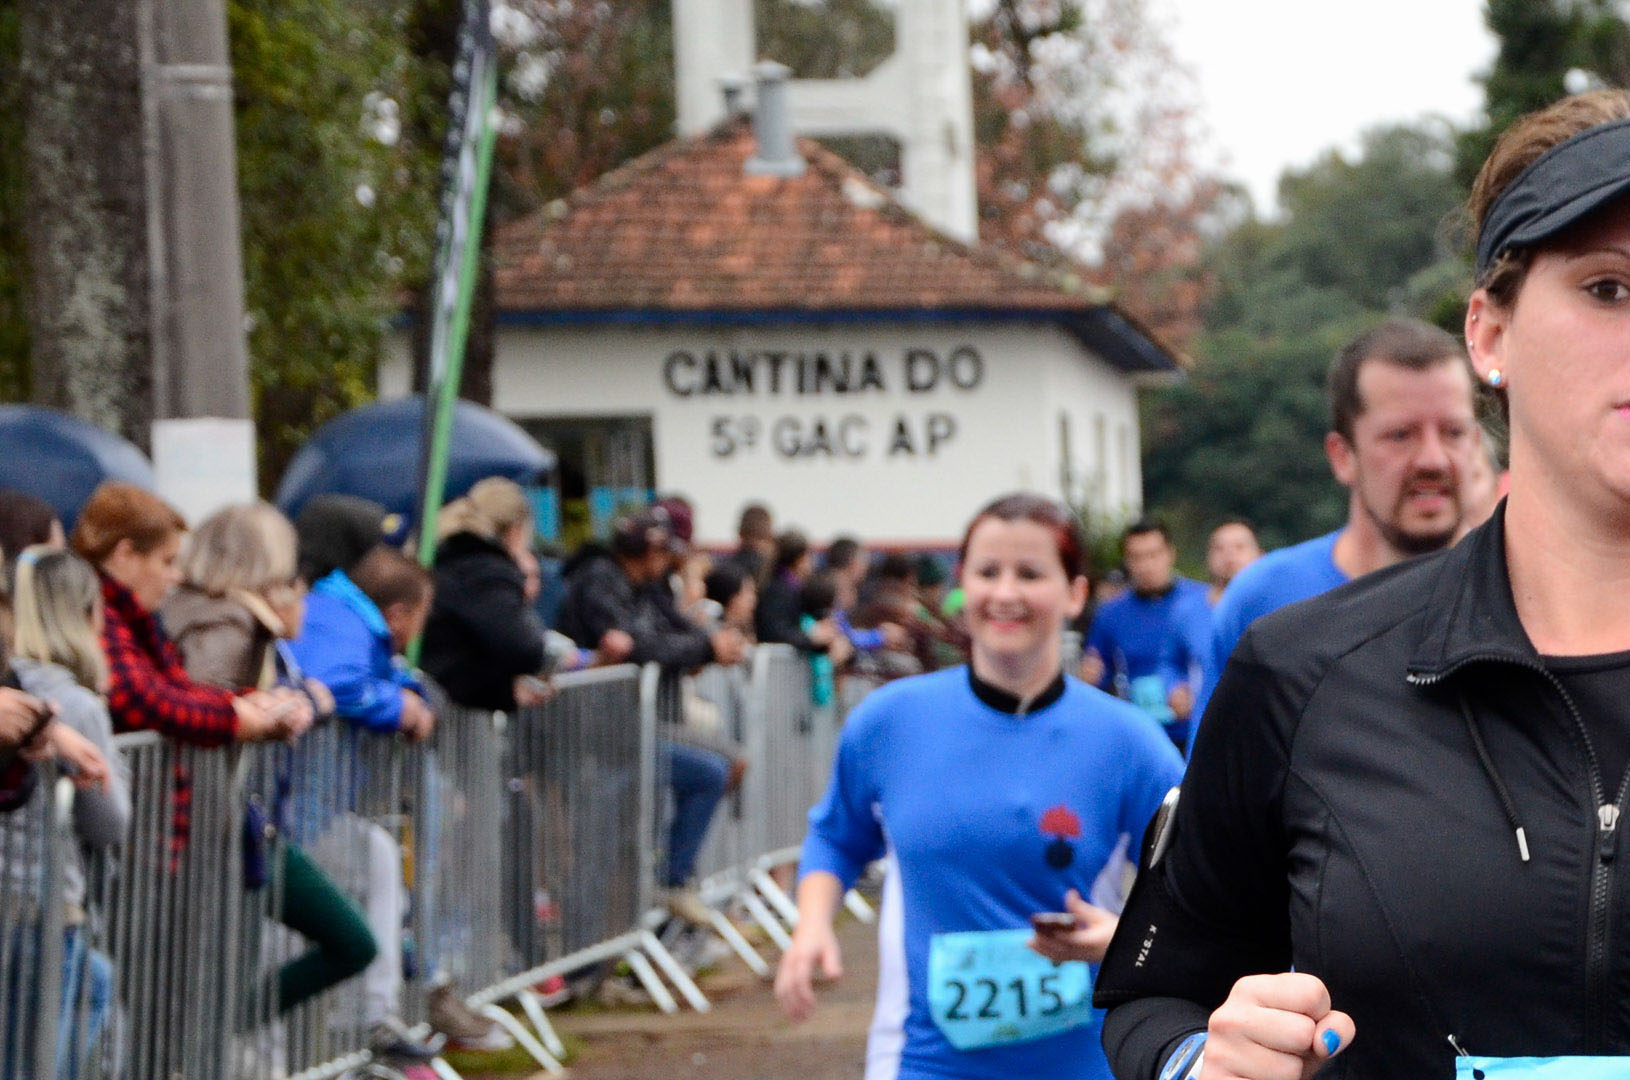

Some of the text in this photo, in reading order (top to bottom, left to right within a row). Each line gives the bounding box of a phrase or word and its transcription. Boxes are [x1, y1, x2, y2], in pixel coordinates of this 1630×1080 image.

[664, 344, 985, 396] CANTINA DO
[772, 413, 868, 459] GAC
[944, 974, 1063, 1020] 2215
